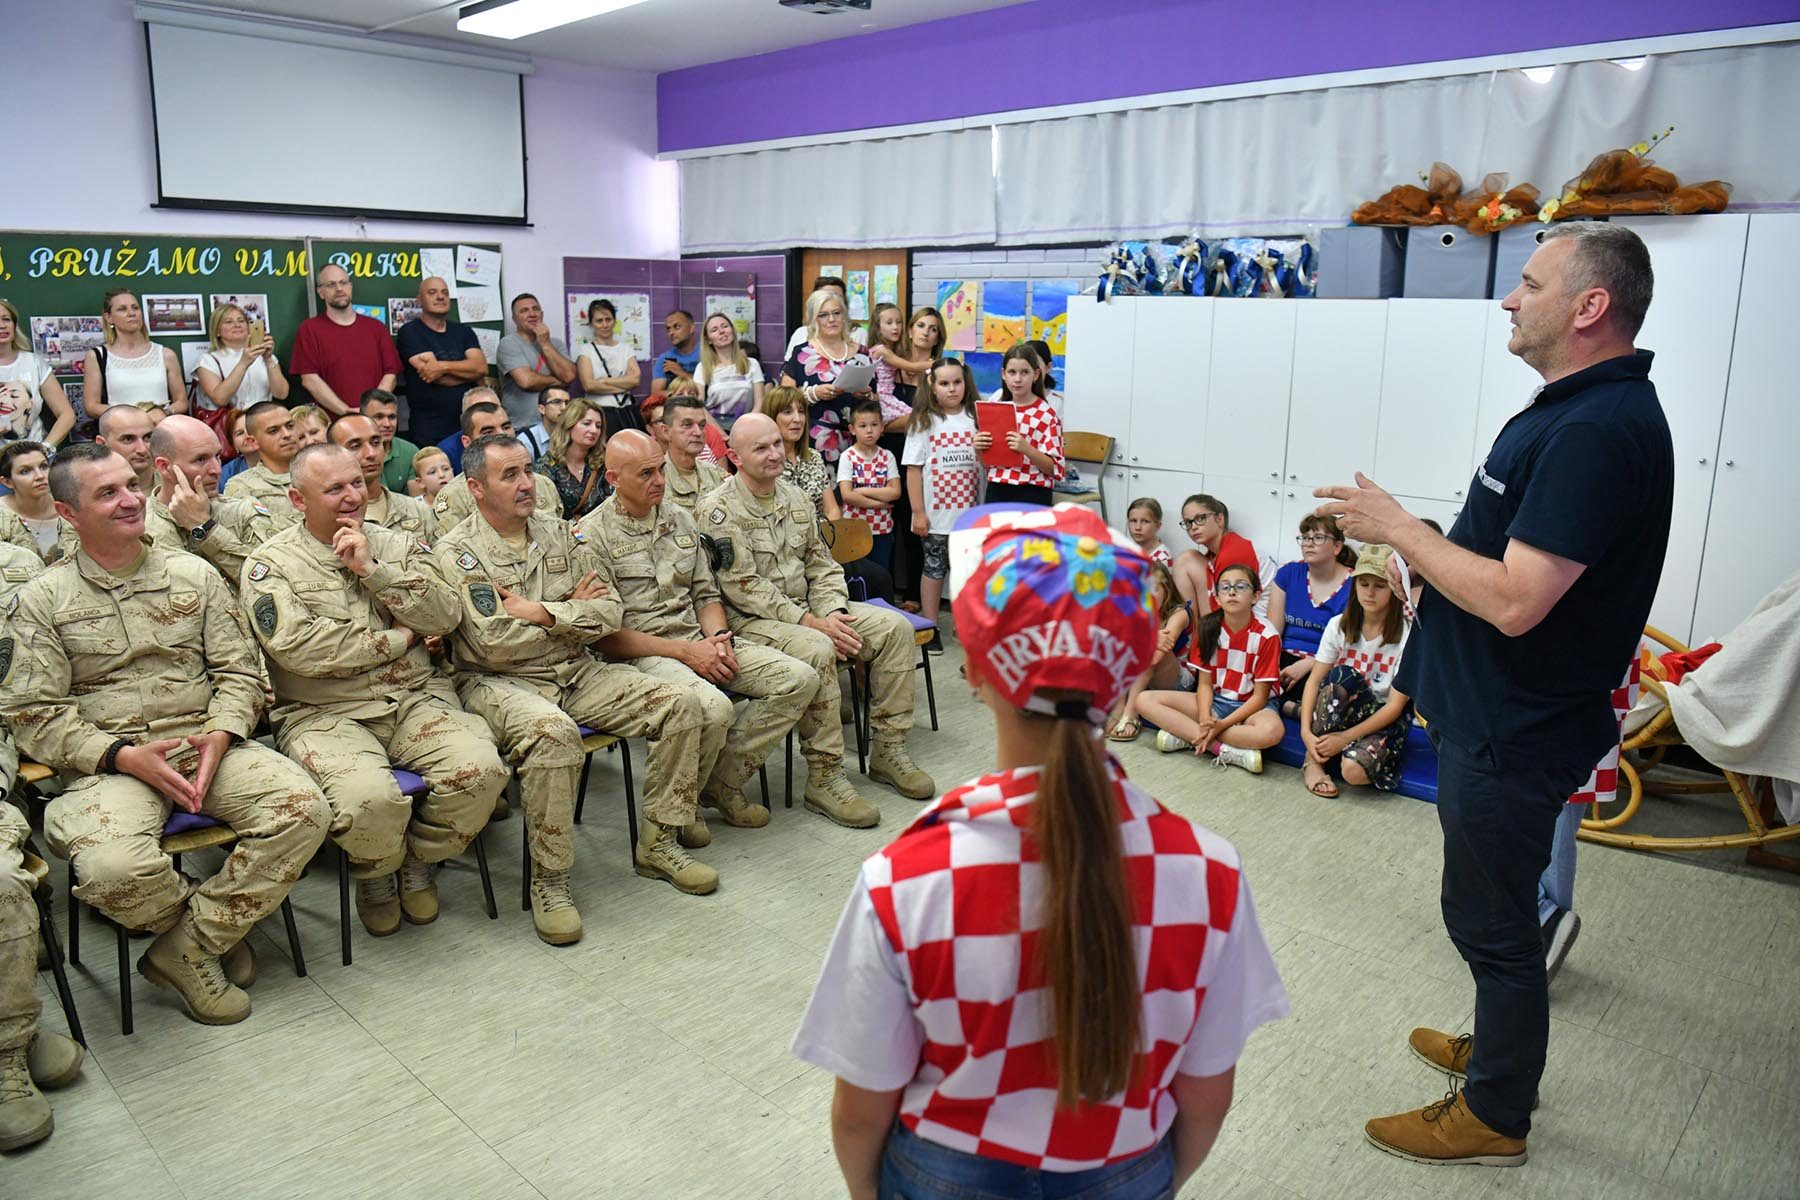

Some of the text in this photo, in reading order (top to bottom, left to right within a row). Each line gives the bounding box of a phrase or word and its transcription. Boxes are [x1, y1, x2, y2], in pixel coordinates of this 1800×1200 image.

[28, 240, 221, 278] PRUŽAMO
[235, 247, 309, 277] VAM
[328, 251, 421, 278] RUKU
